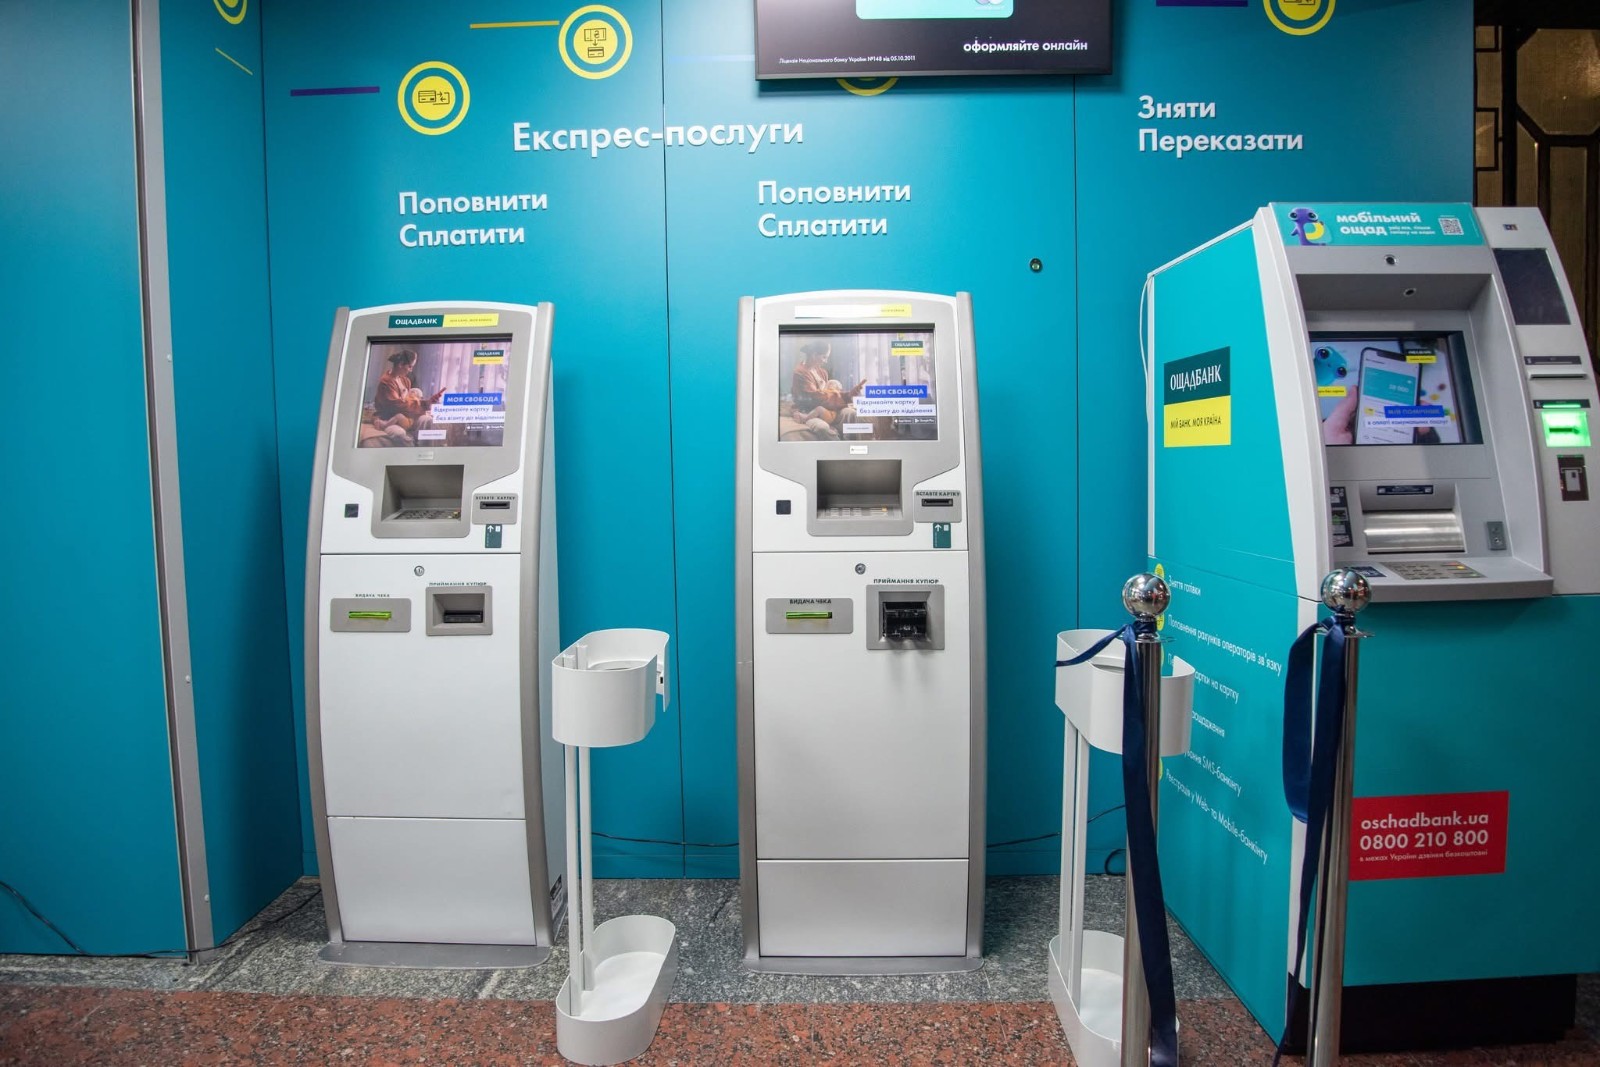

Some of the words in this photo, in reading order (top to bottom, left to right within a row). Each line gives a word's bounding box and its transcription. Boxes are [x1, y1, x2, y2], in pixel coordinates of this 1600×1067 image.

[963, 39, 1040, 53] оформляйте
[1042, 39, 1088, 51] онлайн
[1138, 95, 1216, 119] Зняти
[513, 122, 804, 158] Експрес-послуги
[1139, 128, 1304, 159] Переказати
[399, 191, 548, 215] Поповнити
[758, 180, 911, 205] Поповнити
[758, 213, 888, 238] Сплатити
[1336, 212, 1421, 223] мобільний
[399, 223, 526, 248] Сплатити
[1340, 225, 1388, 236] ощад
[1170, 364, 1222, 392] ОЩАДБАНК
[1183, 583, 1201, 596] готівки
[1168, 614, 1197, 636] Поповнення
[1197, 630, 1221, 645] рахунків
[1221, 640, 1256, 663] операторів
[1195, 671, 1211, 685] артки
[1211, 678, 1219, 689] на
[1219, 683, 1239, 704] картку
[1202, 755, 1242, 797] SMS-банкінгу
[1361, 811, 1489, 830] oschadbank.ua
[1218, 811, 1268, 865] Mobile-банкінгу
[1360, 833, 1409, 850] 0800
[1414, 831, 1447, 848] 210
[1453, 829, 1489, 846] 800
[1390, 853, 1417, 862] України
[1445, 849, 1488, 858] безкоштовні
